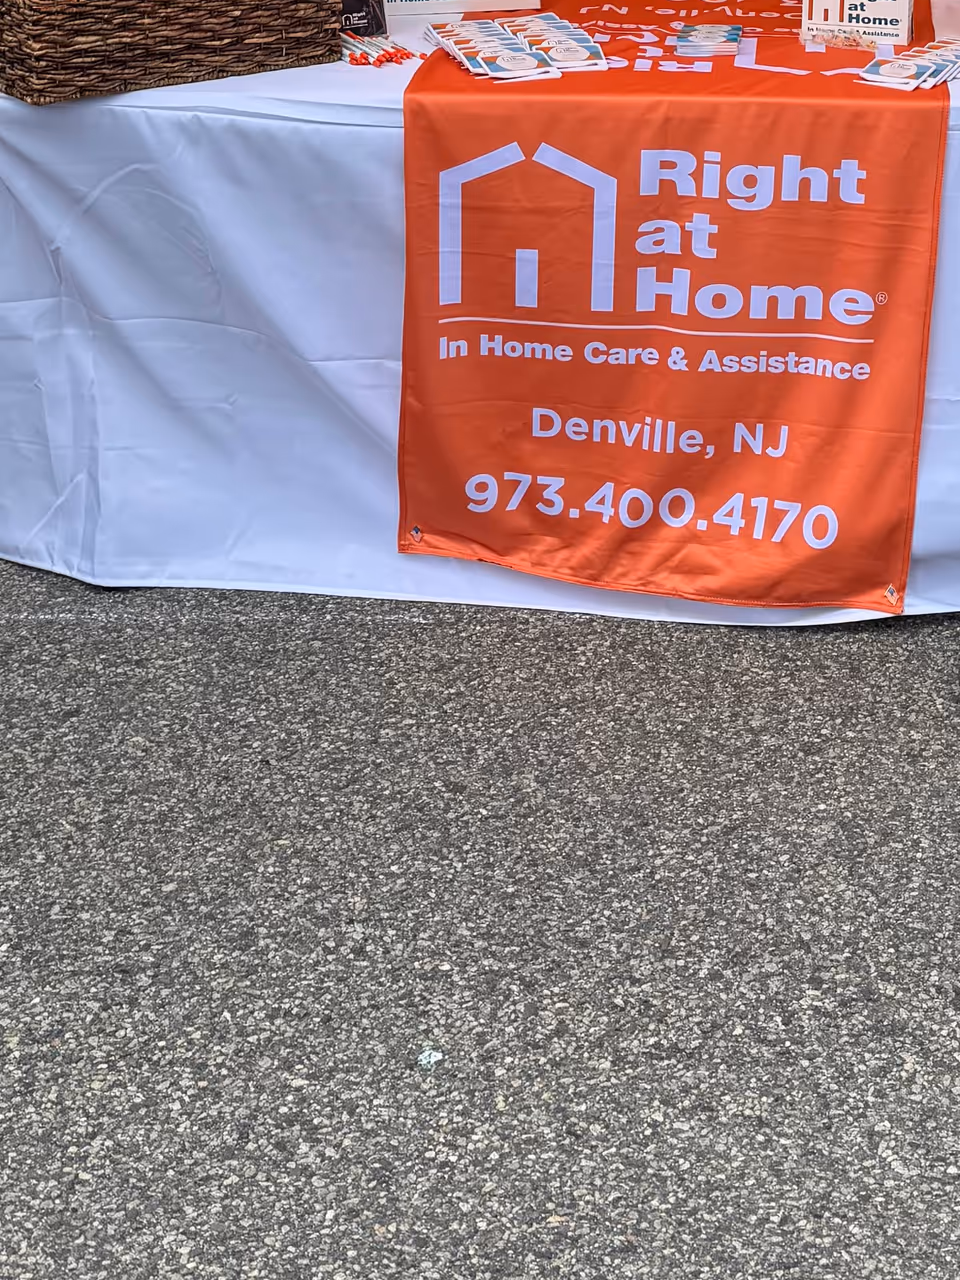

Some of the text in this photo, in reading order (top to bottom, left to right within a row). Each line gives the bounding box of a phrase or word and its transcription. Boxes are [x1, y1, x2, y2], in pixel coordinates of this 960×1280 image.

[848, 2, 866, 12] at
[848, 13, 900, 26] Home
[862, 30, 900, 38] Assistance
[639, 149, 868, 211] Right
[635, 212, 718, 259] at
[439, 334, 871, 381] In Home Care & Assistance
[531, 407, 790, 460] Denville, NJ
[464, 471, 839, 550] 973.400.4170
